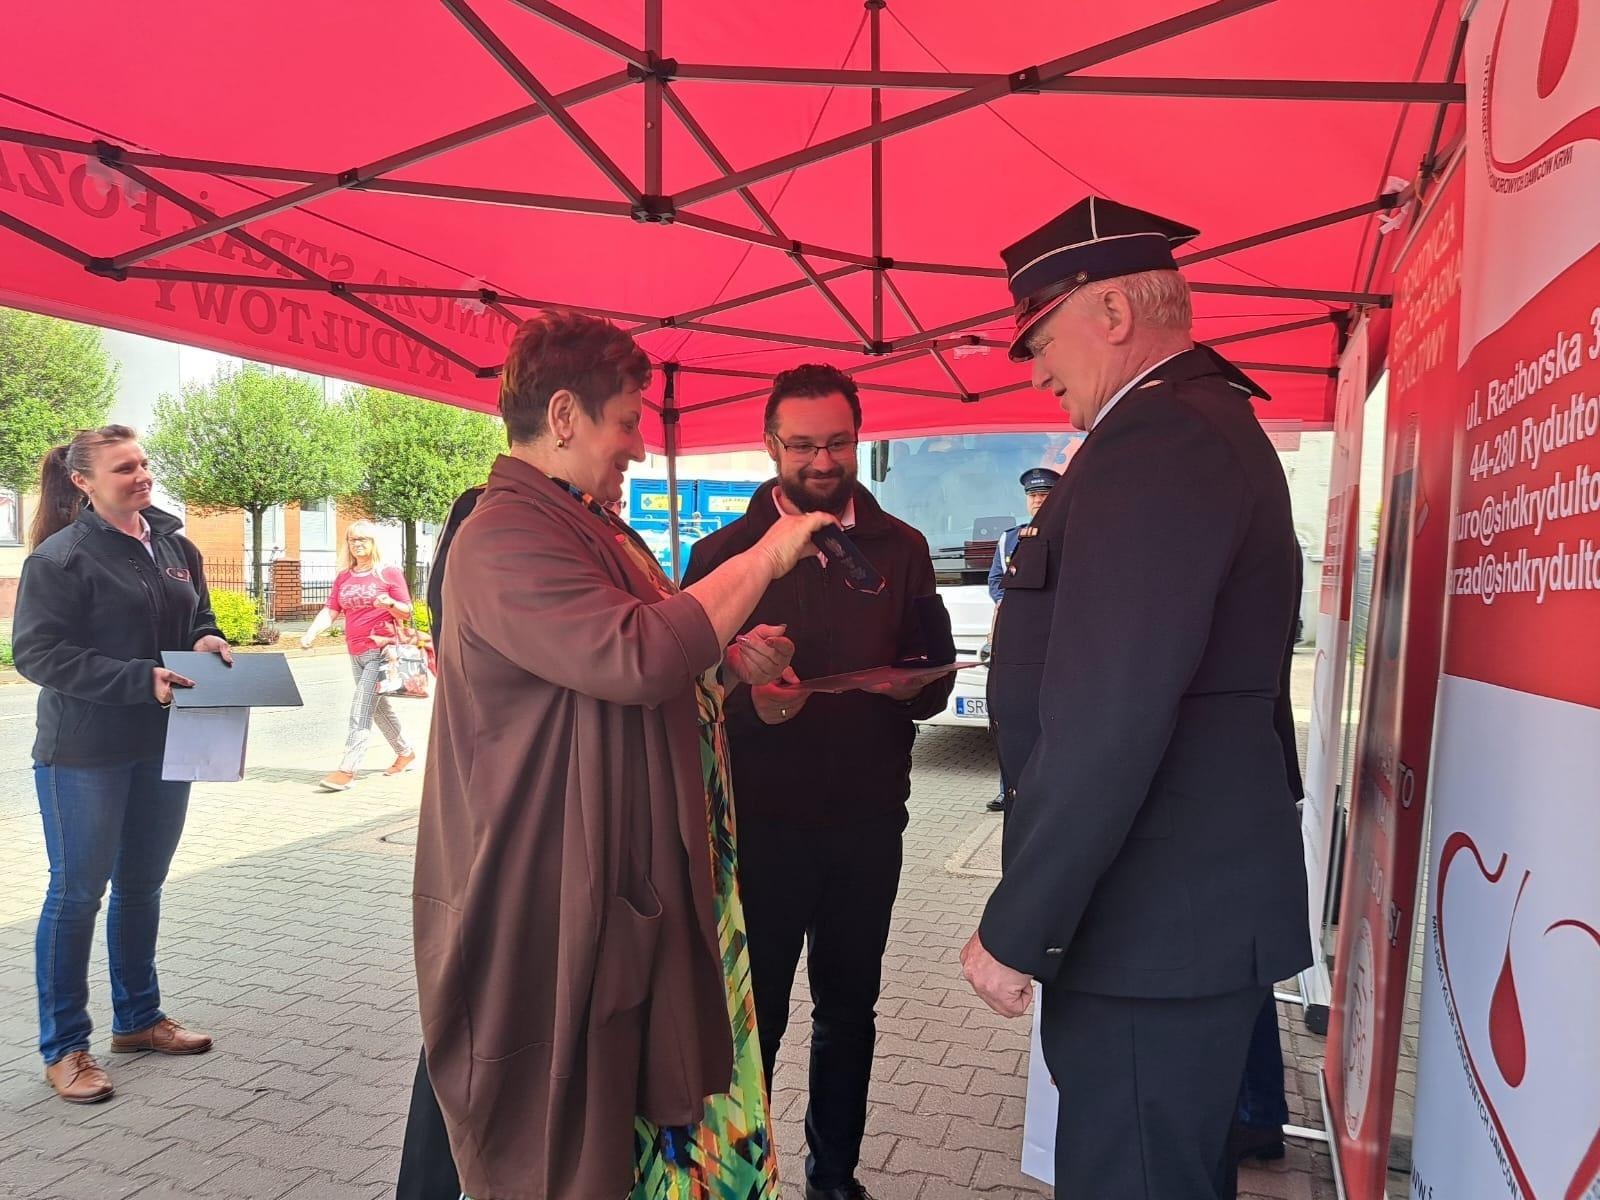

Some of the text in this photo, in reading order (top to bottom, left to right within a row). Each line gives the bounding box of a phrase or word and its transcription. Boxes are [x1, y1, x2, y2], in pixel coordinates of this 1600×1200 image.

[1466, 389, 1484, 431] ul.
[1486, 331, 1582, 421] Raciborska
[1469, 392, 1600, 481] 44-280 Rydułto
[1455, 464, 1600, 546] iuro@shdkrydulto
[966, 699, 988, 714] SR
[1453, 1023, 1489, 1132] HONOROWYCH
